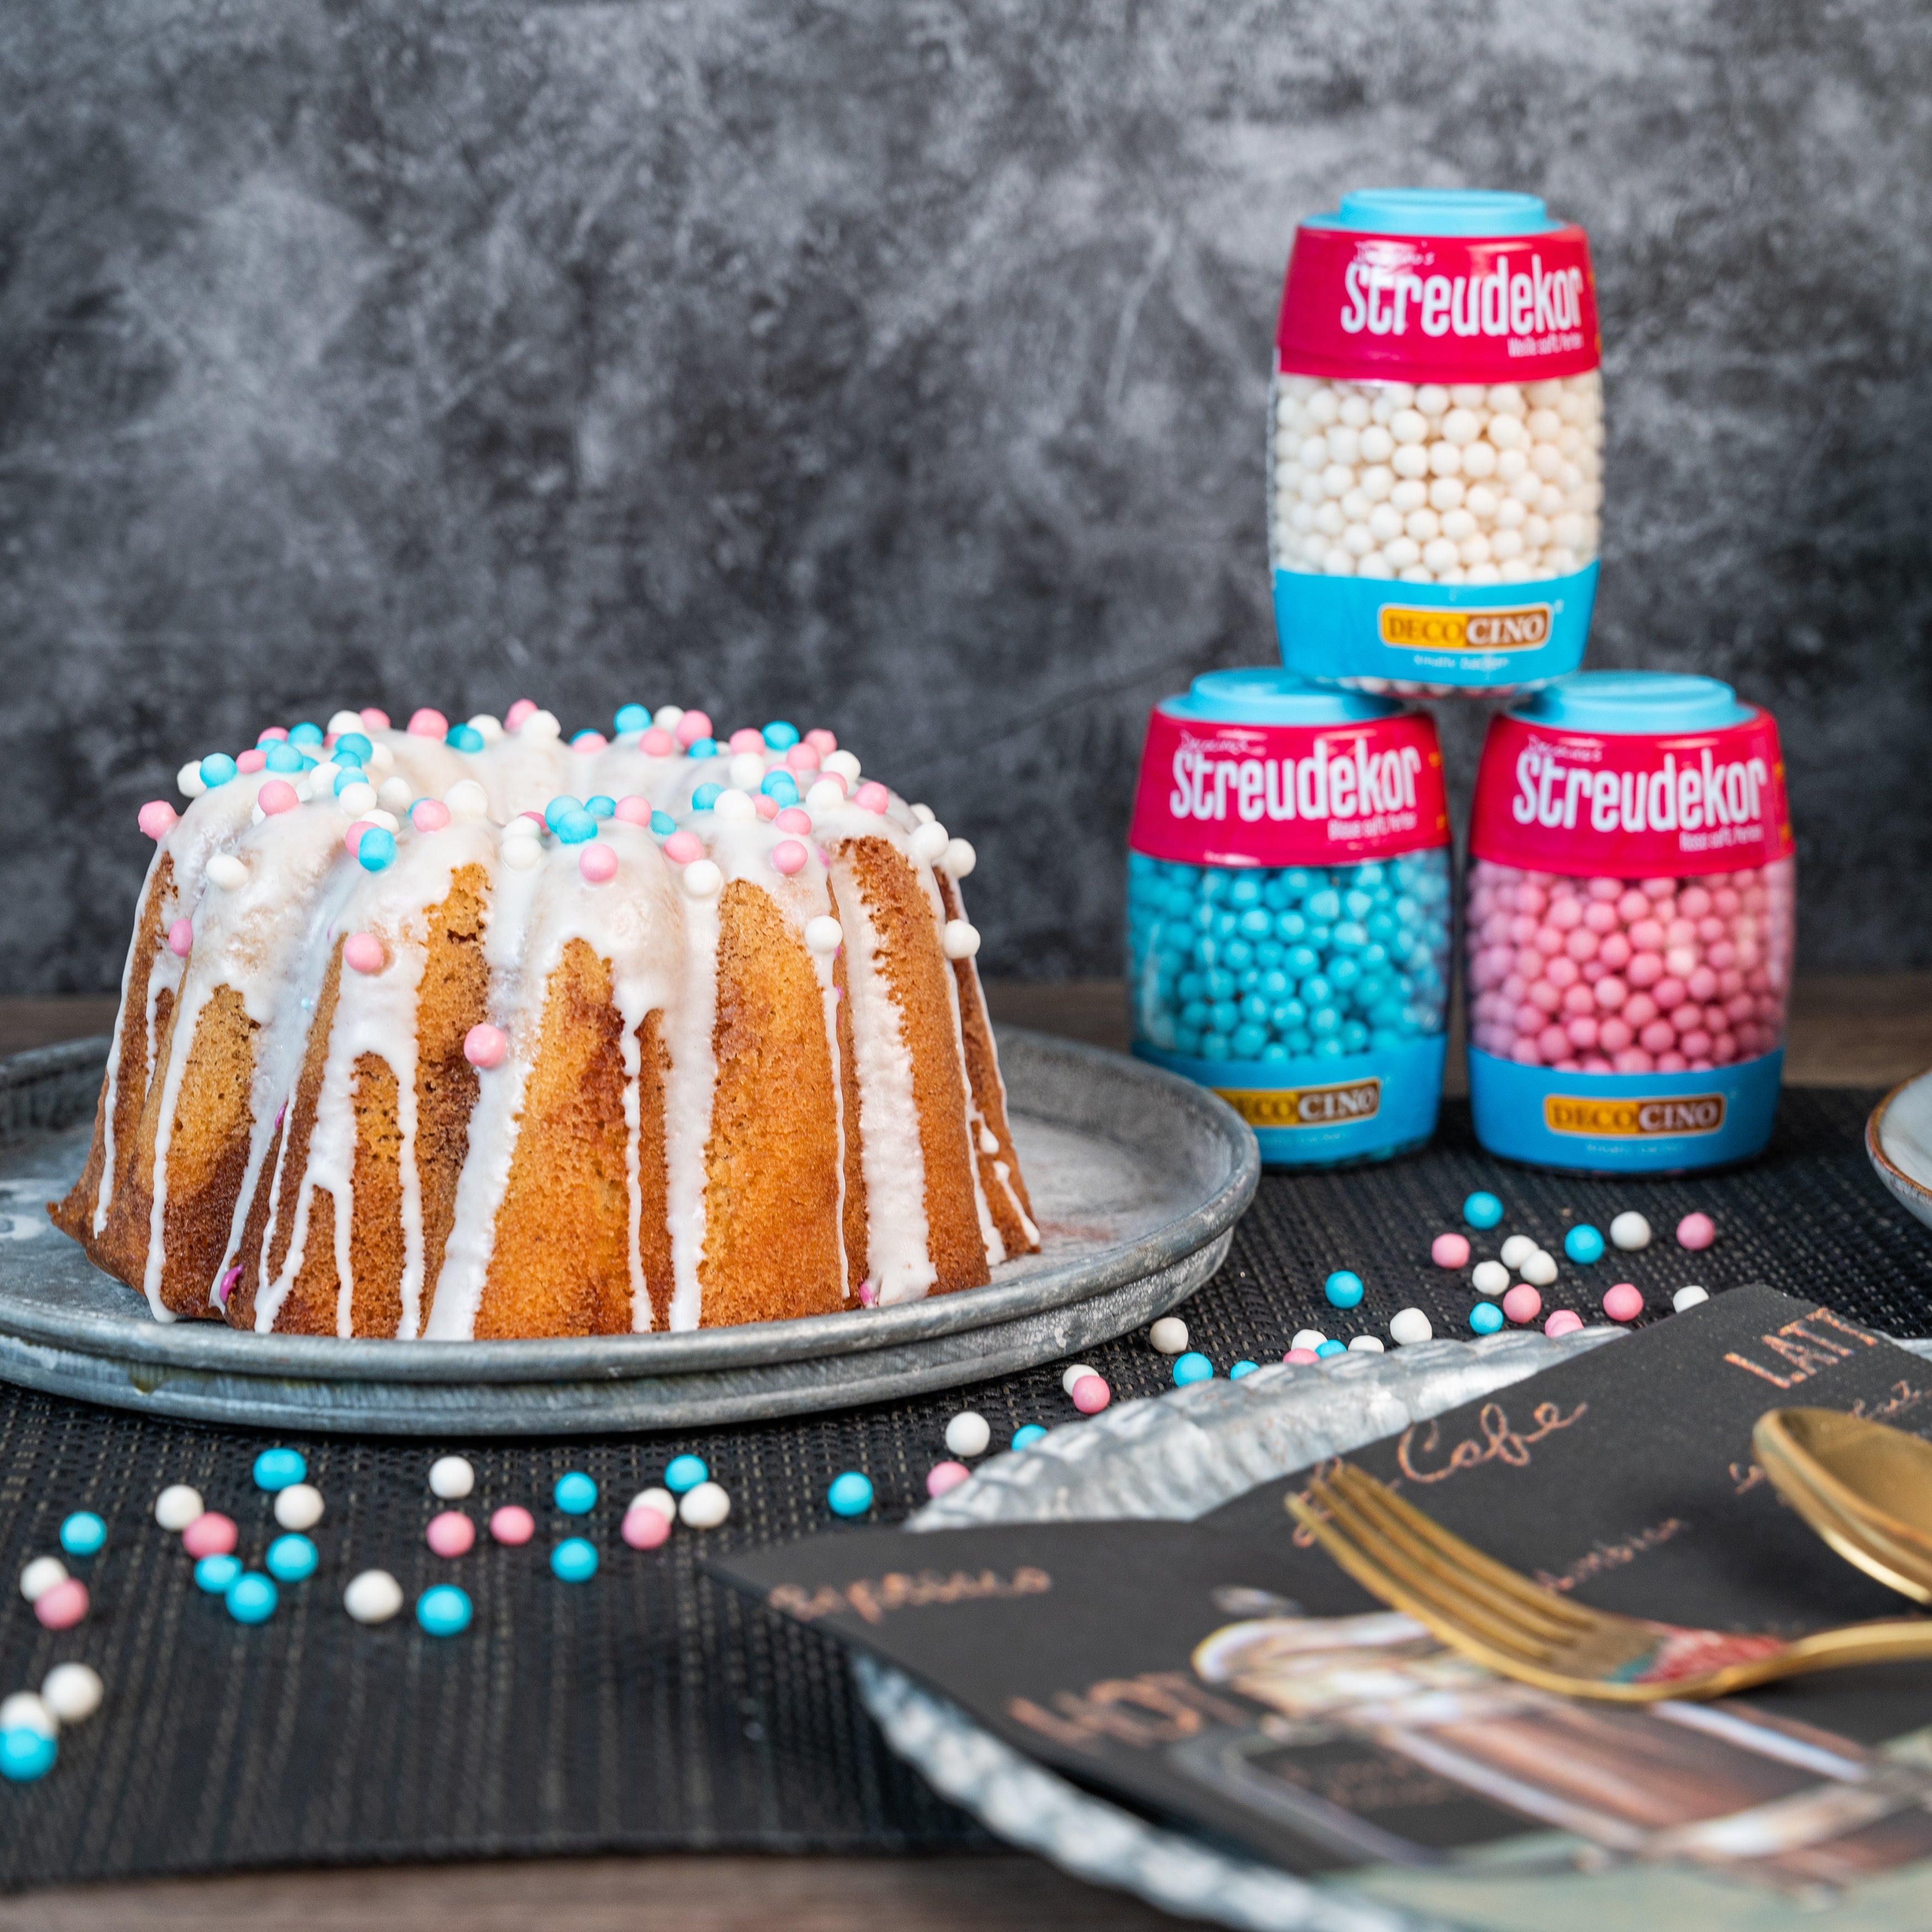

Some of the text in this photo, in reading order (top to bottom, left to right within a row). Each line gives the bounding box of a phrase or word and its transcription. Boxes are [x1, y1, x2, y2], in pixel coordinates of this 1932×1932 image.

[1340, 253, 1583, 337] Streudekor
[1388, 613, 1544, 646] DECOCINO
[1169, 736, 1421, 822] Streudekor
[1512, 748, 1766, 833] Streudekor
[1552, 1101, 1719, 1132] DECOCINO
